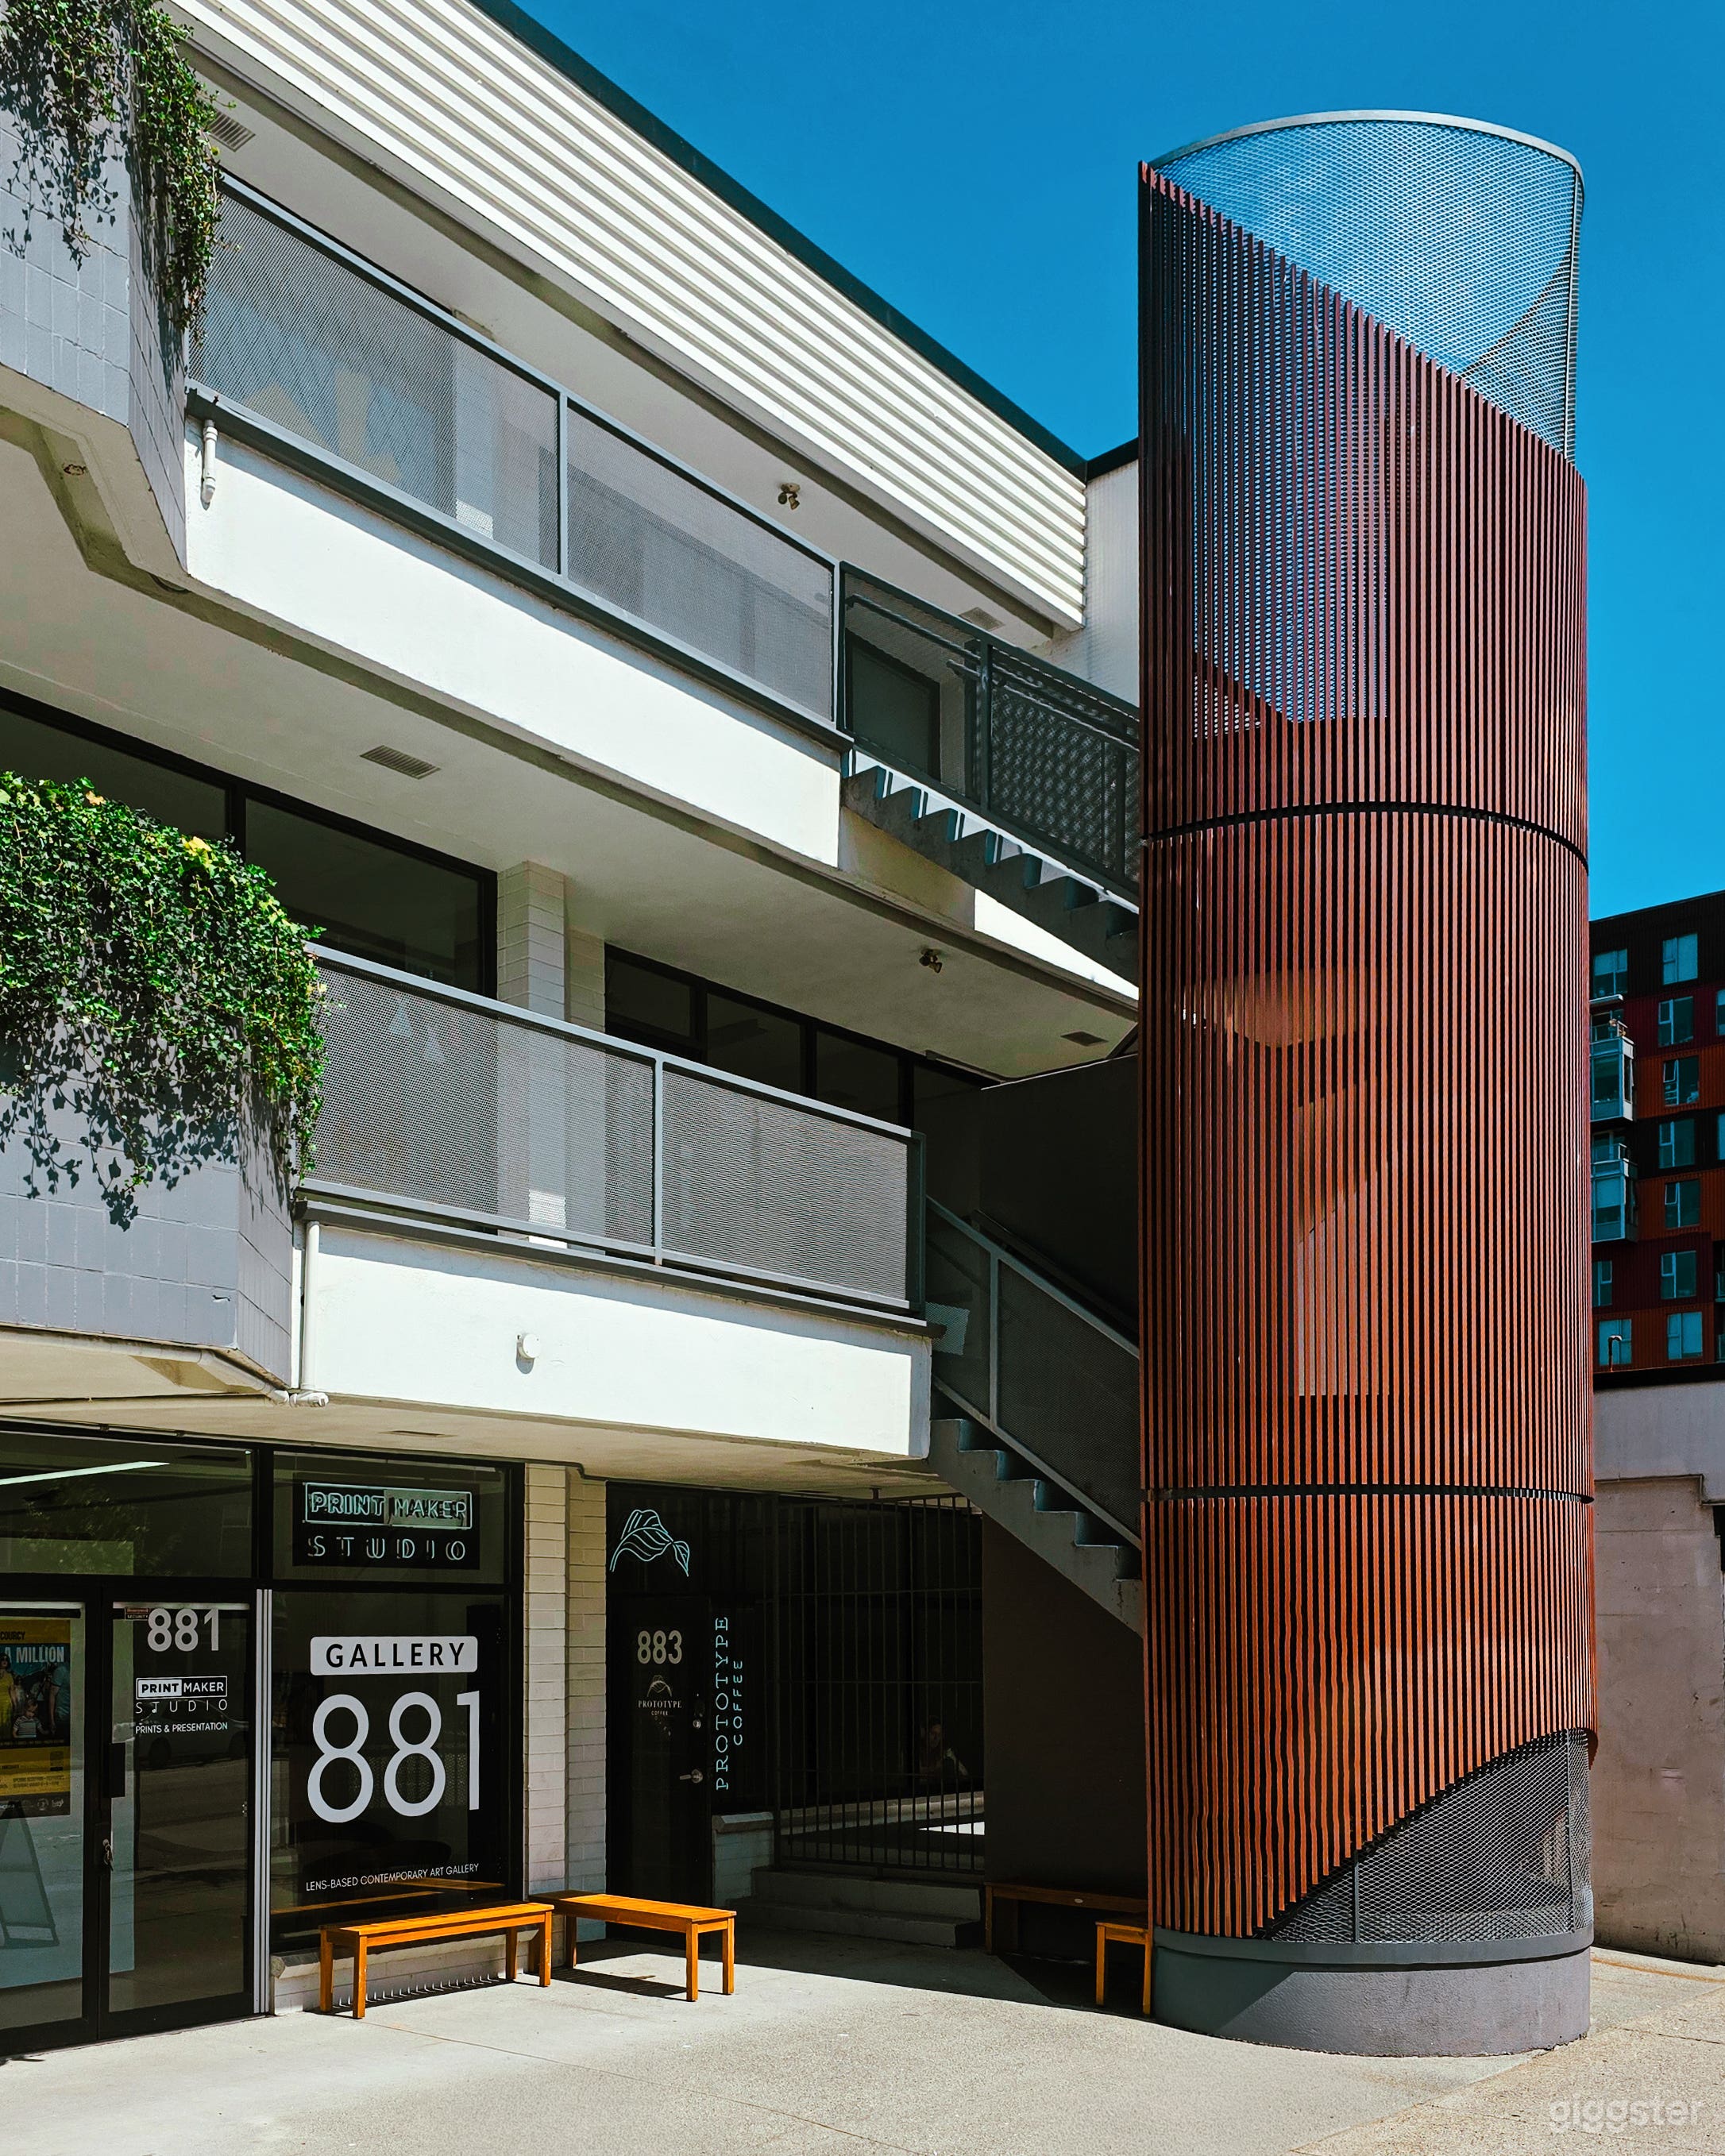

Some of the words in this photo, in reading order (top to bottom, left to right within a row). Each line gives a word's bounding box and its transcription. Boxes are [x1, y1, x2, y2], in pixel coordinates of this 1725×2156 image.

[310, 1491, 385, 1517] PRINT
[394, 1497, 467, 1518] MAKER
[308, 1535, 466, 1560] STUDIO
[147, 1607, 219, 1653] 881
[16, 1646, 64, 1663] MILLION
[326, 1642, 465, 1668] GALLERY
[637, 1630, 683, 1664] 883
[141, 1683, 179, 1694] PRINT
[183, 1681, 224, 1693] MAKER
[135, 1699, 228, 1714] STUDIO
[715, 1617, 729, 1791] PROTOTYPE
[733, 1660, 743, 1746] COFFEE
[135, 1724, 163, 1734] PRINTS
[164, 1724, 170, 1733] &
[172, 1722, 228, 1733] PRESENTATION
[307, 1690, 480, 1823] 881
[306, 1876, 359, 1892] LENS-BASED
[360, 1869, 429, 1885] CONTEMPORARY
[430, 1866, 444, 1876] ART
[446, 1863, 480, 1875] GALLERY
